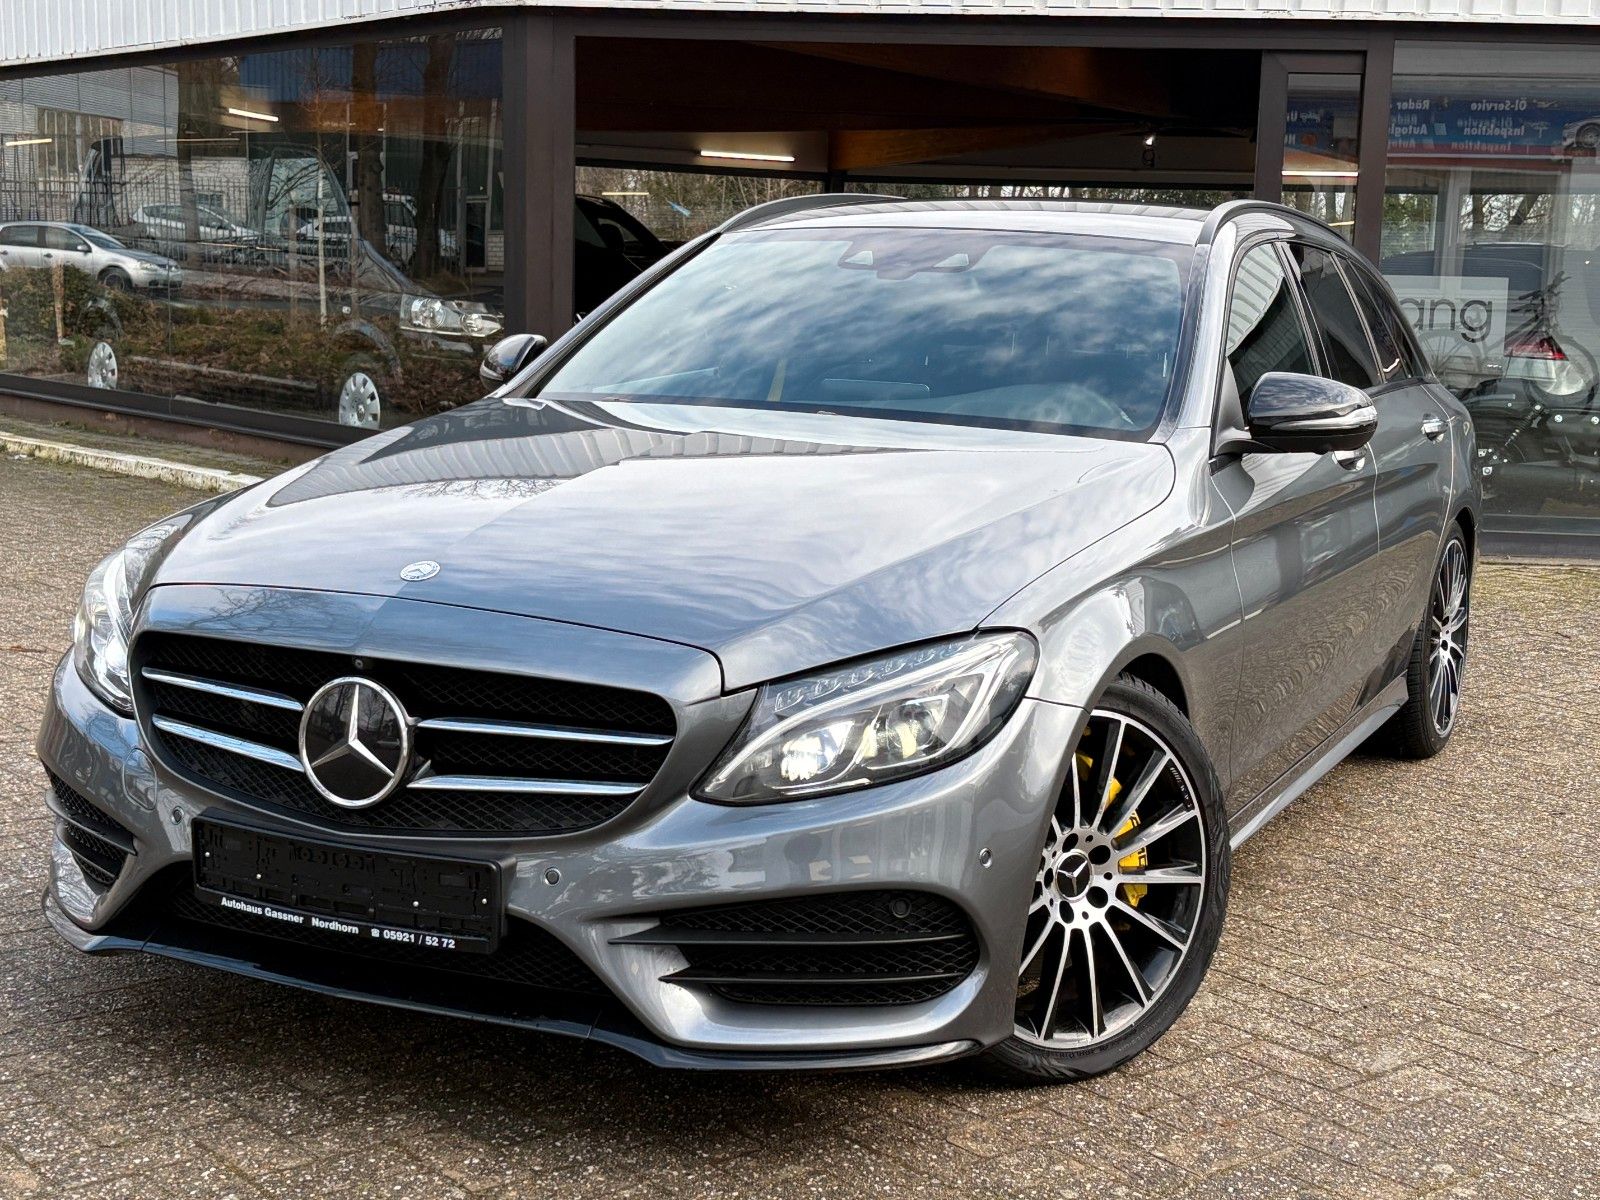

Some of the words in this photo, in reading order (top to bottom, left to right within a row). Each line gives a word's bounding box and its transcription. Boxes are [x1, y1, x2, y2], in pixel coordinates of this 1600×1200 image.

[221, 897, 263, 915] Autohaus
[264, 907, 304, 924] Gassner
[311, 917, 359, 934] Nordhorn
[383, 929, 415, 943] 05921
[425, 935, 439, 947] 52
[441, 938, 456, 949] 72
